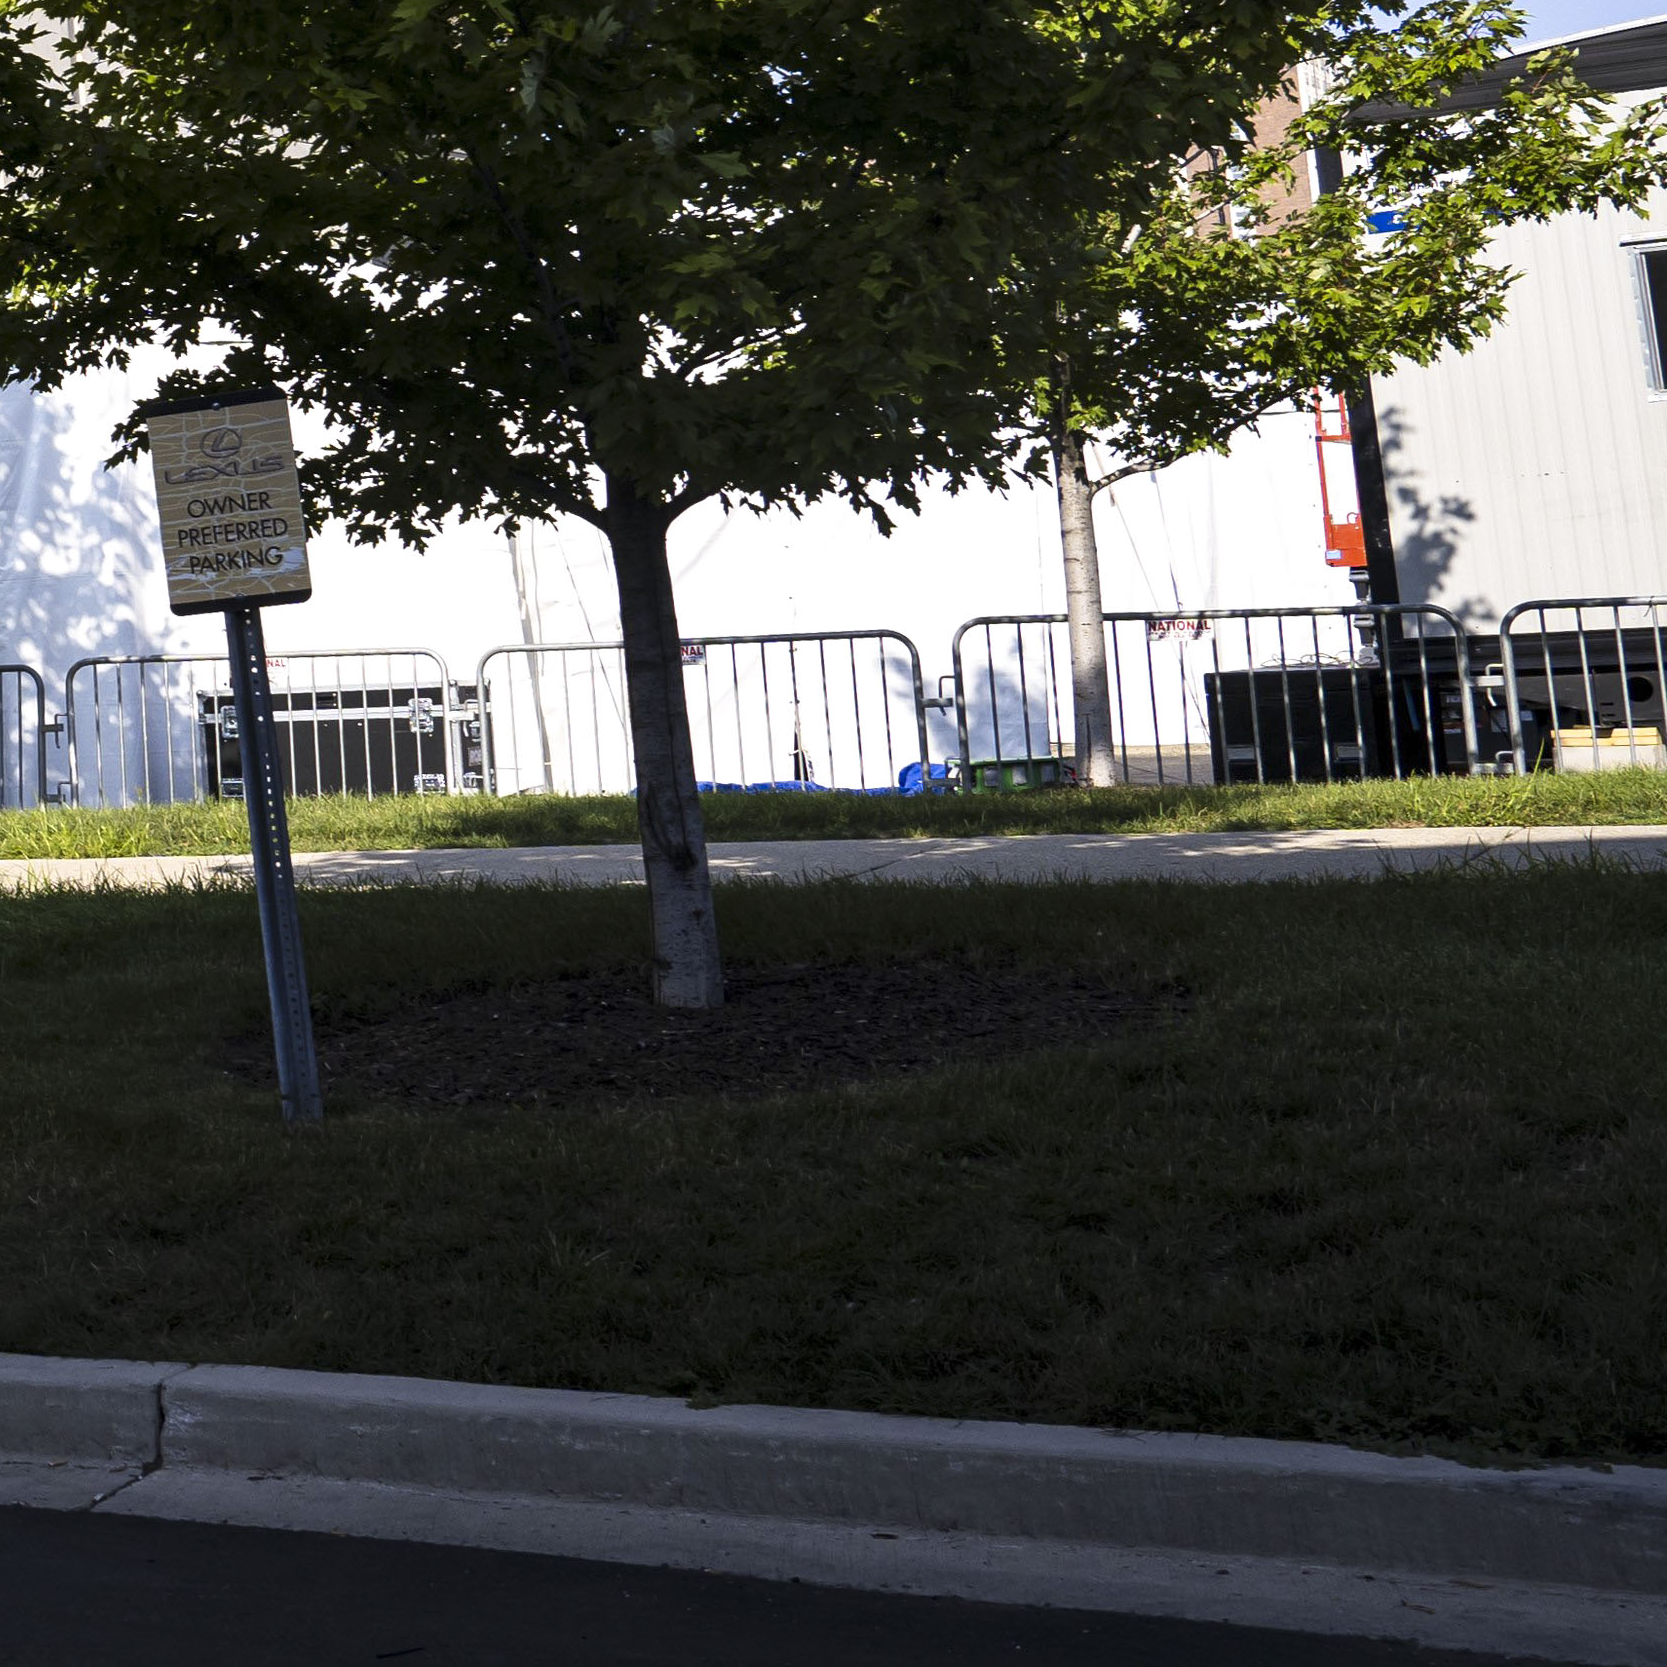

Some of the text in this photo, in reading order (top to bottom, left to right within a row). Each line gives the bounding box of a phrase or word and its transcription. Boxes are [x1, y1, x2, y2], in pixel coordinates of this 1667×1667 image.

[187, 491, 272, 518] OWNER
[178, 517, 289, 547] PREFERRED
[190, 546, 284, 574] PARKING
[1148, 619, 1212, 632] NATIONAL
